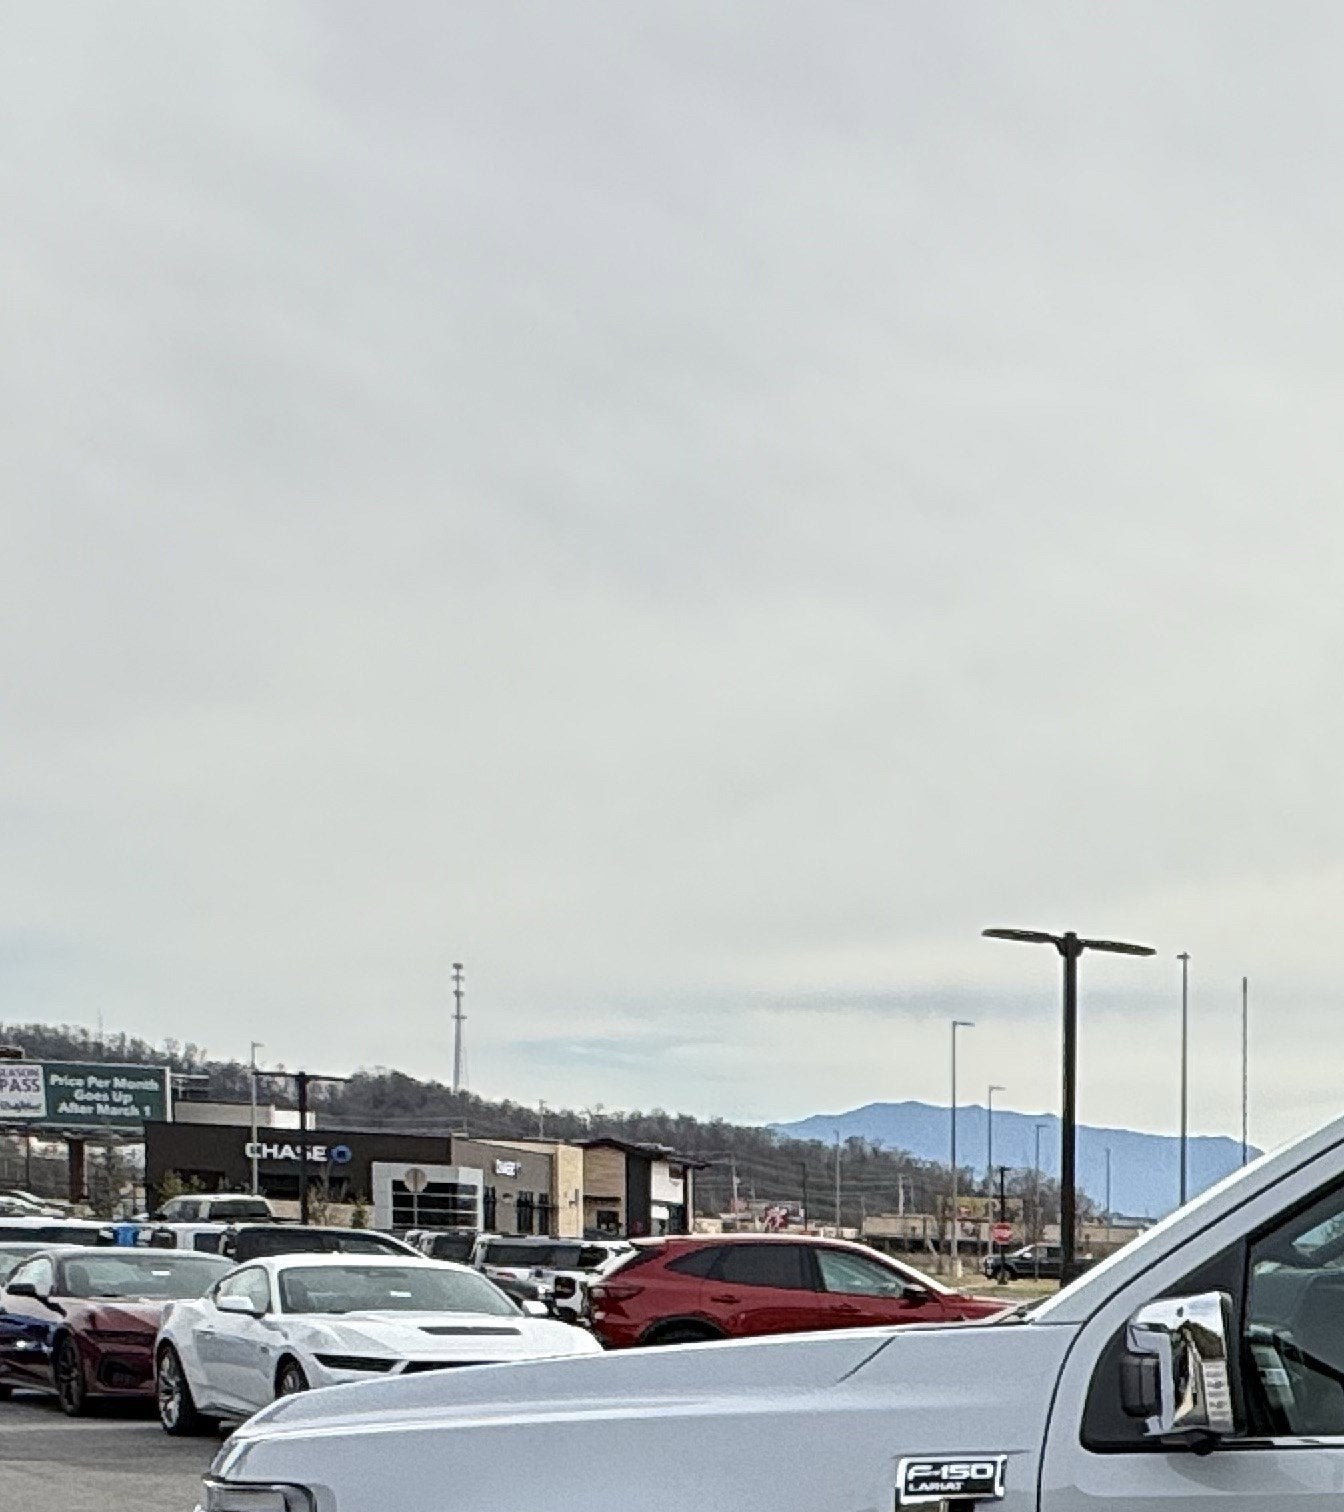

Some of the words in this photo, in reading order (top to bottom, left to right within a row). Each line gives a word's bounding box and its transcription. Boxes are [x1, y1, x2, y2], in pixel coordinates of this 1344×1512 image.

[50, 1074, 85, 1087] Price
[87, 1075, 111, 1088] Per
[112, 1076, 160, 1091] Month
[74, 1088, 110, 1102] Goes
[111, 1090, 134, 1105] Up
[57, 1101, 94, 1114] After
[96, 1103, 140, 1116] March
[245, 1142, 328, 1162] CHASE
[907, 1463, 994, 1480] F-150
